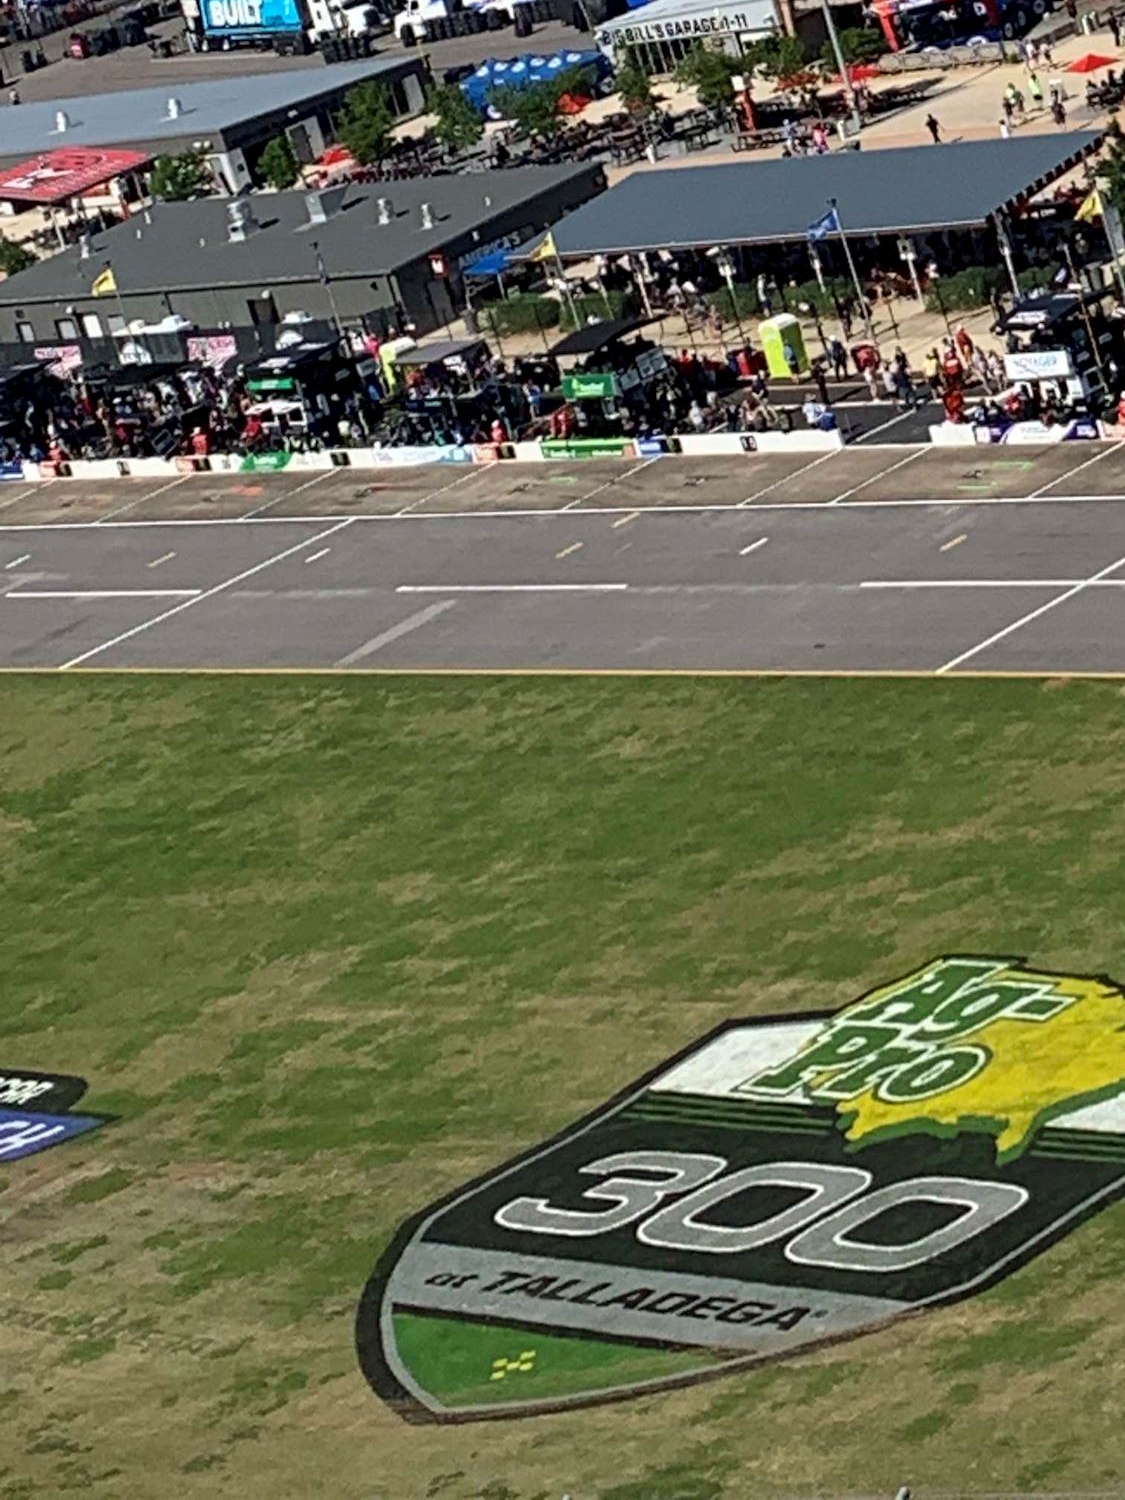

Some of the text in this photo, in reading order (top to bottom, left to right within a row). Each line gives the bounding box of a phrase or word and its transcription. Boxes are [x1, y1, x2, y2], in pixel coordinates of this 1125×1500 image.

[665, 15, 720, 37] GARAGE
[730, 1022, 987, 1103] Pro
[494, 1150, 1030, 1273] 300
